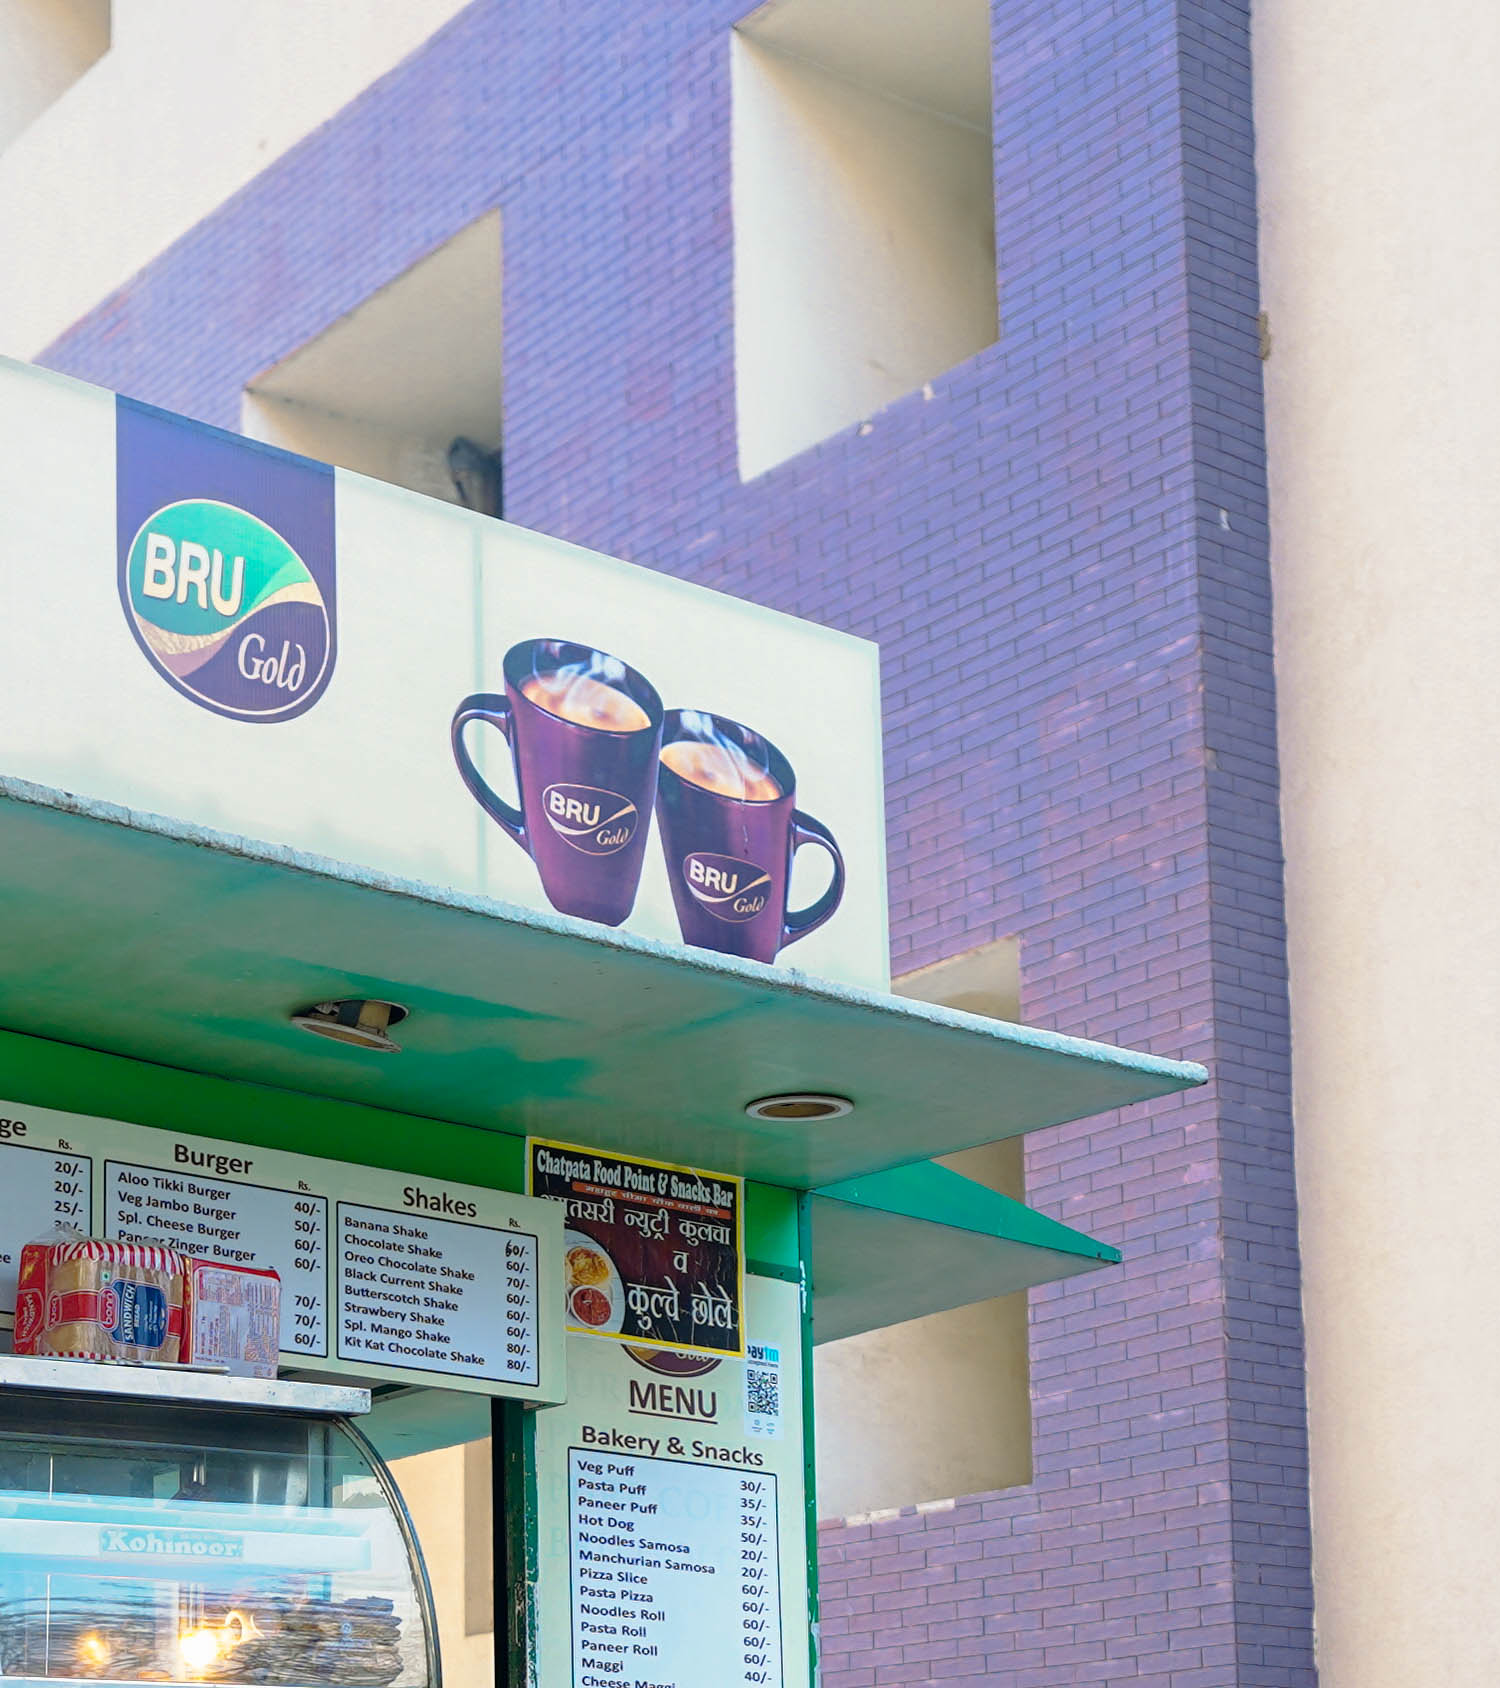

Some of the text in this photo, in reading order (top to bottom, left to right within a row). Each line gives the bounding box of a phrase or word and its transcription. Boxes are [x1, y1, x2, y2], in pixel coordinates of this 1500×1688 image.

[143, 532, 245, 617] BRU
[238, 633, 307, 692] Gold
[550, 789, 601, 826] BRU
[596, 826, 631, 847] Gold
[689, 858, 739, 895] BRU
[733, 896, 766, 914] Gold
[58, 1138, 72, 1150] Rs.
[174, 1143, 253, 1175] Burger
[54, 1161, 83, 1177] 20/-
[536, 1149, 592, 1184] Chatpata
[593, 1160, 622, 1184] Food
[623, 1165, 656, 1193] Point
[657, 1173, 669, 1195] &
[670, 1175, 713, 1205] Snacks
[713, 1187, 734, 1208] Bar
[117, 1171, 231, 1200] Aloo Tikki Burger
[294, 1201, 320, 1216] 40/-
[402, 1186, 476, 1218] Shakes
[679, 1216, 731, 1247] कुलचा
[344, 1250, 474, 1281] Oreo Chocolate Shake
[673, 1250, 690, 1275] व
[506, 1274, 537, 1294] 70/-
[123, 1283, 137, 1342] SANDWICH
[690, 1281, 734, 1330] छोले
[344, 1335, 485, 1365] Kit Kat Chocolate Shake
[629, 1379, 716, 1418] MENU
[582, 1425, 763, 1466] Bakery & Snacks
[577, 1459, 635, 1476] Veg Puff
[740, 1480, 766, 1494] 30/-
[579, 1549, 715, 1574] Manchurian Samosa
[581, 1657, 623, 1673] Maggi
